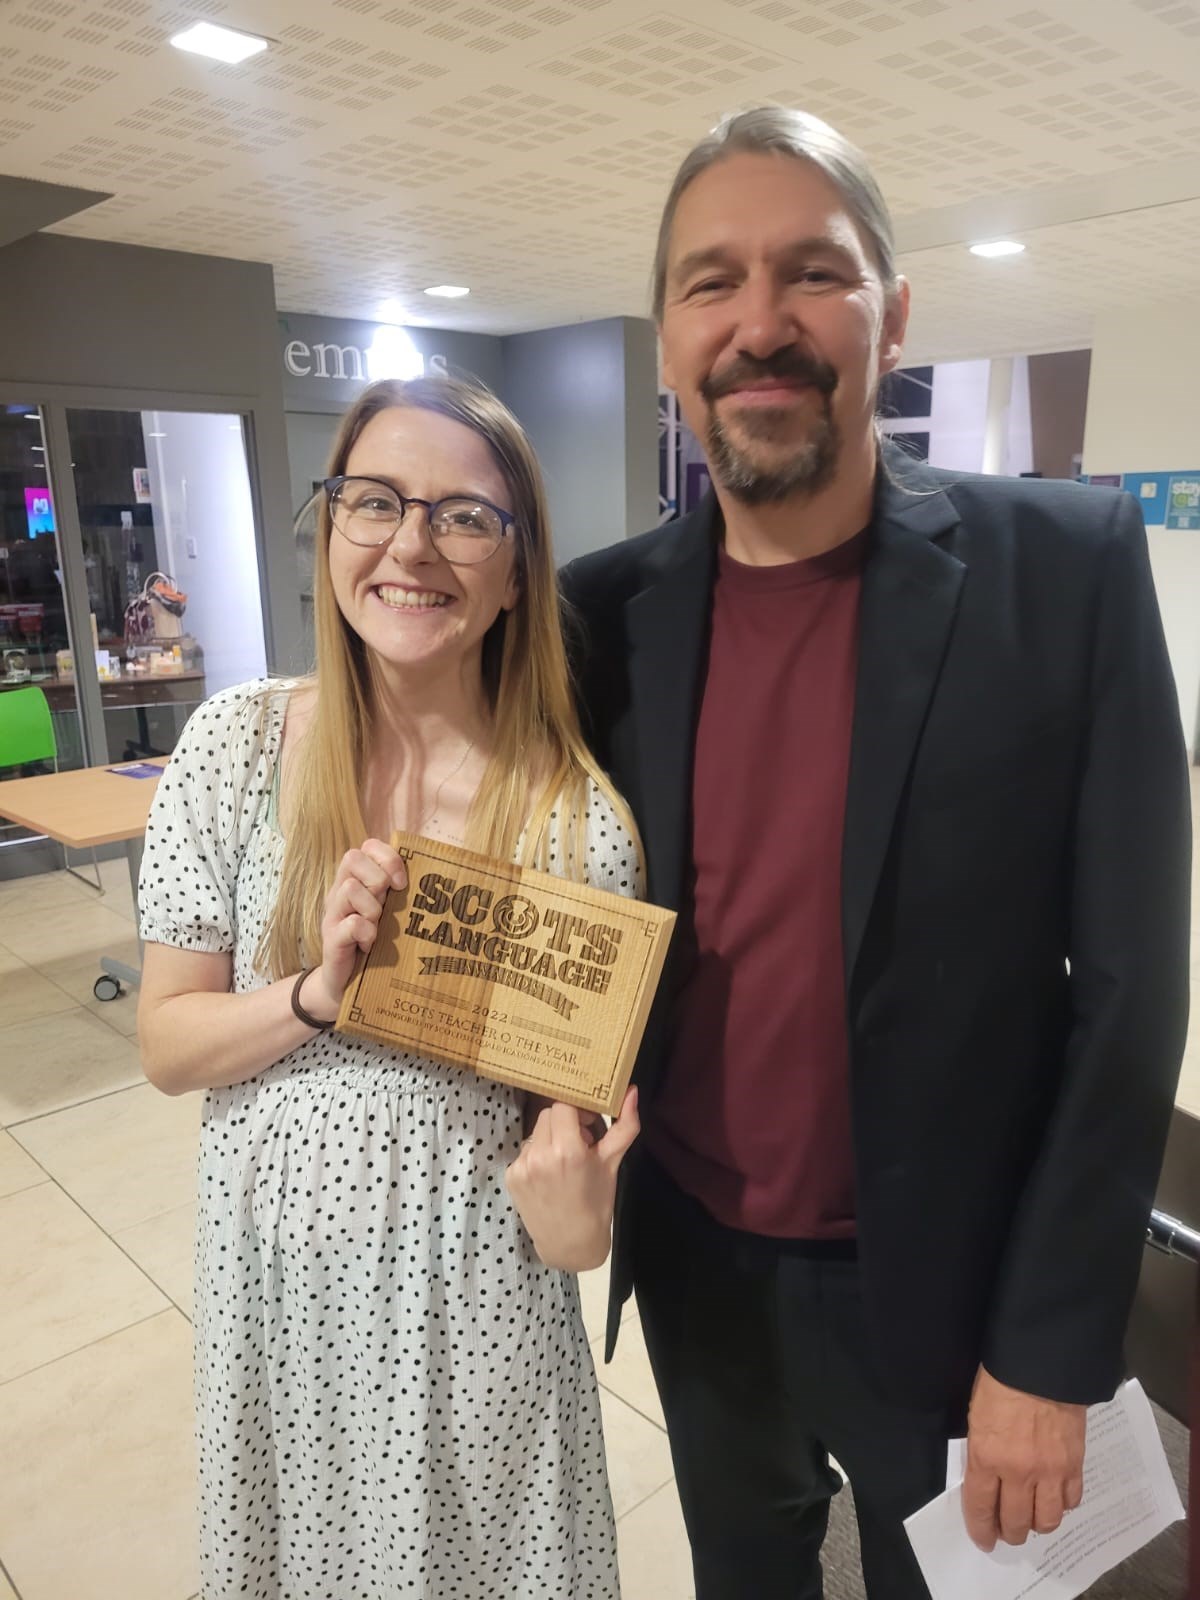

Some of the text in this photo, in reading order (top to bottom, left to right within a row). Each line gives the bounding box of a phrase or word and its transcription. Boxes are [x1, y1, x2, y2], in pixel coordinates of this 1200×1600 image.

[284, 340, 448, 380] ems
[404, 912, 612, 994] LANGUAGE
[414, 873, 624, 967] SCOTS
[392, 998, 578, 1065] SCOTS TEACHER O THE YEAR
[471, 1004, 509, 1024] 2022
